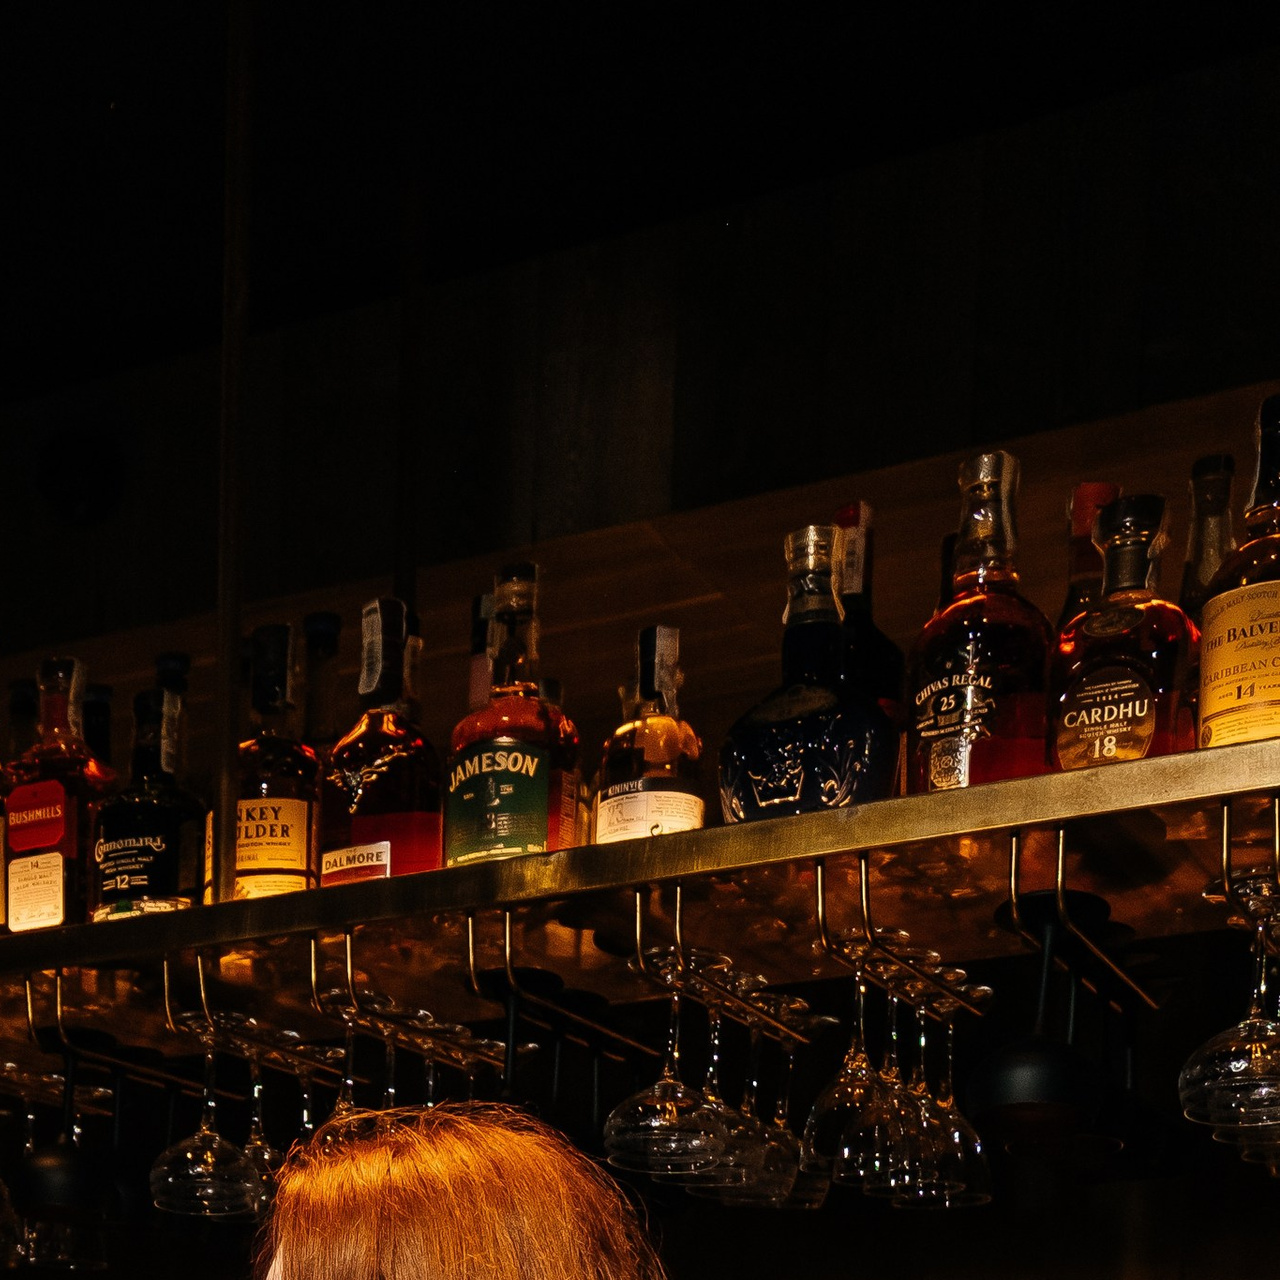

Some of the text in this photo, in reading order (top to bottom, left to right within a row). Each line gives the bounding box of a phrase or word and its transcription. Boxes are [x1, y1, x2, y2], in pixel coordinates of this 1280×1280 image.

[1205, 635, 1224, 653] THE
[915, 674, 992, 706] CHIVAS REGAL
[1235, 681, 1256, 700] 14
[940, 694, 956, 711] 25
[1064, 699, 1149, 728] CARDHU
[1093, 735, 1117, 759] 18
[449, 751, 539, 793] JAMESON
[9, 804, 62, 827] BUSHMILLS
[324, 851, 384, 871] DALMORE
[115, 874, 130, 889] 12
